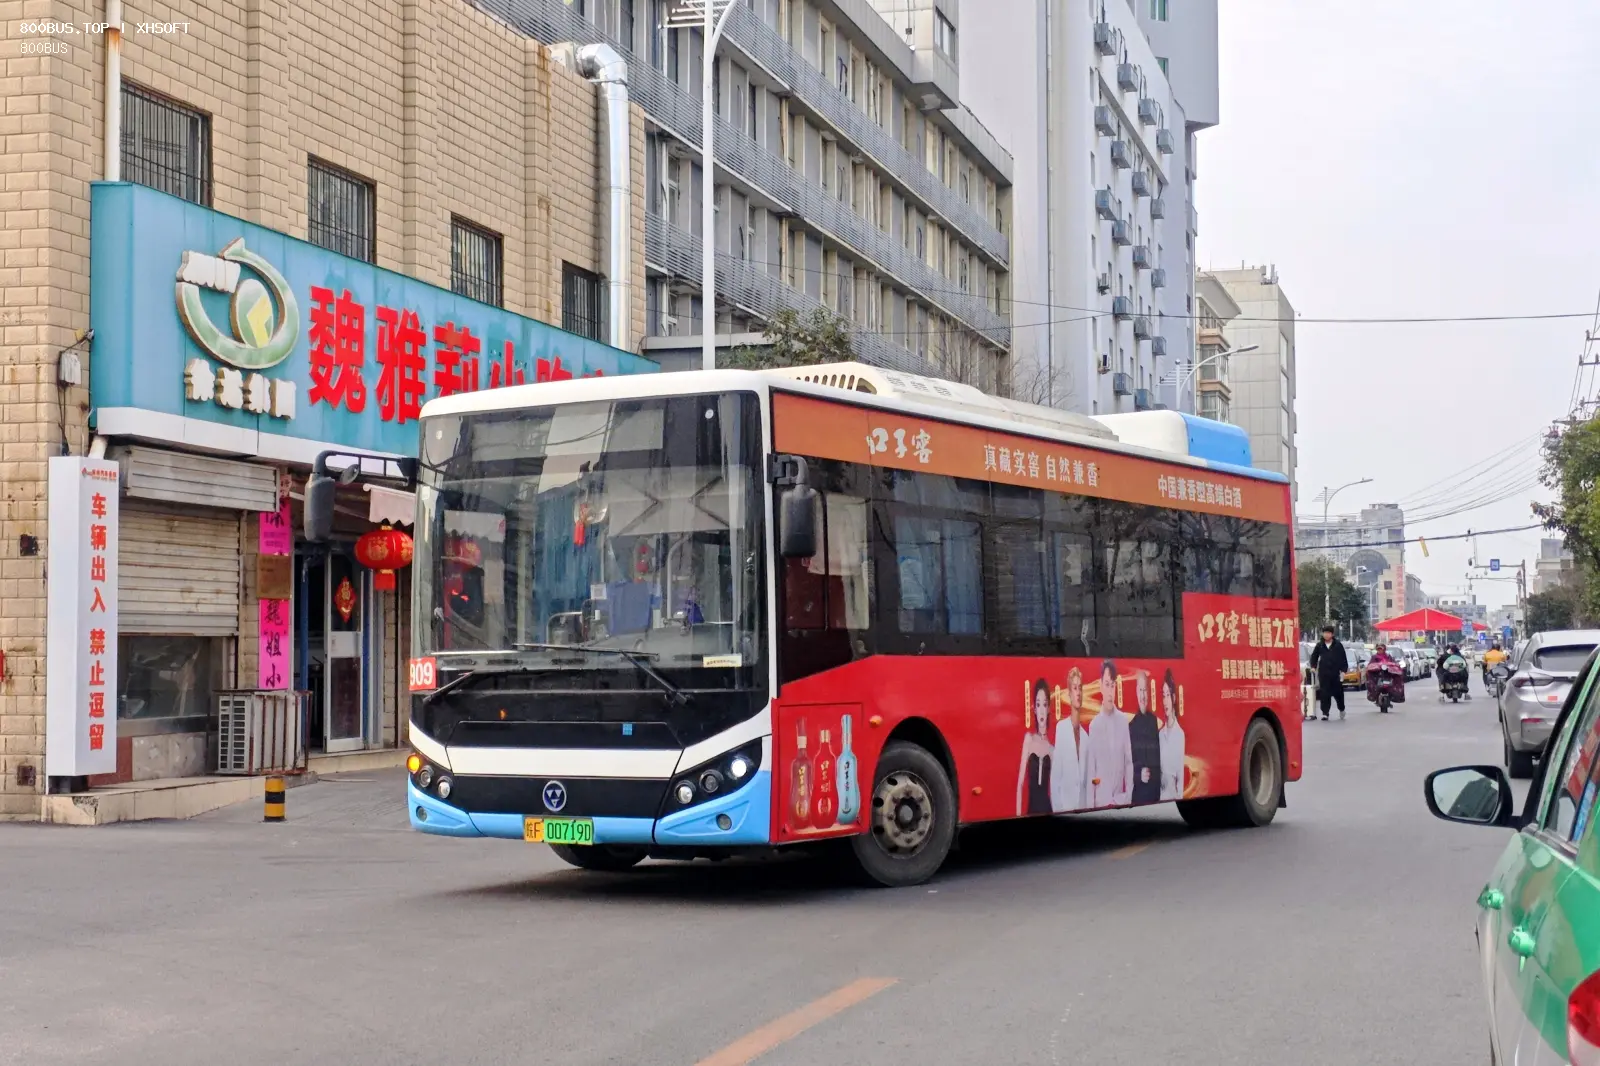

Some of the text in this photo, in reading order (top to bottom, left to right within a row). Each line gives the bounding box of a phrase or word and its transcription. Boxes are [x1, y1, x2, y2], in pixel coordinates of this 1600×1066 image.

[866, 427, 932, 464] 口子窖
[983, 443, 1099, 488] 真藏实窖 自然兼香
[1157, 474, 1242, 509] 中国兼香型高端白酒
[90, 492, 107, 613] 车辆出入
[88, 628, 106, 751] 禁止逗留
[547, 822, 591, 842] 00719D
